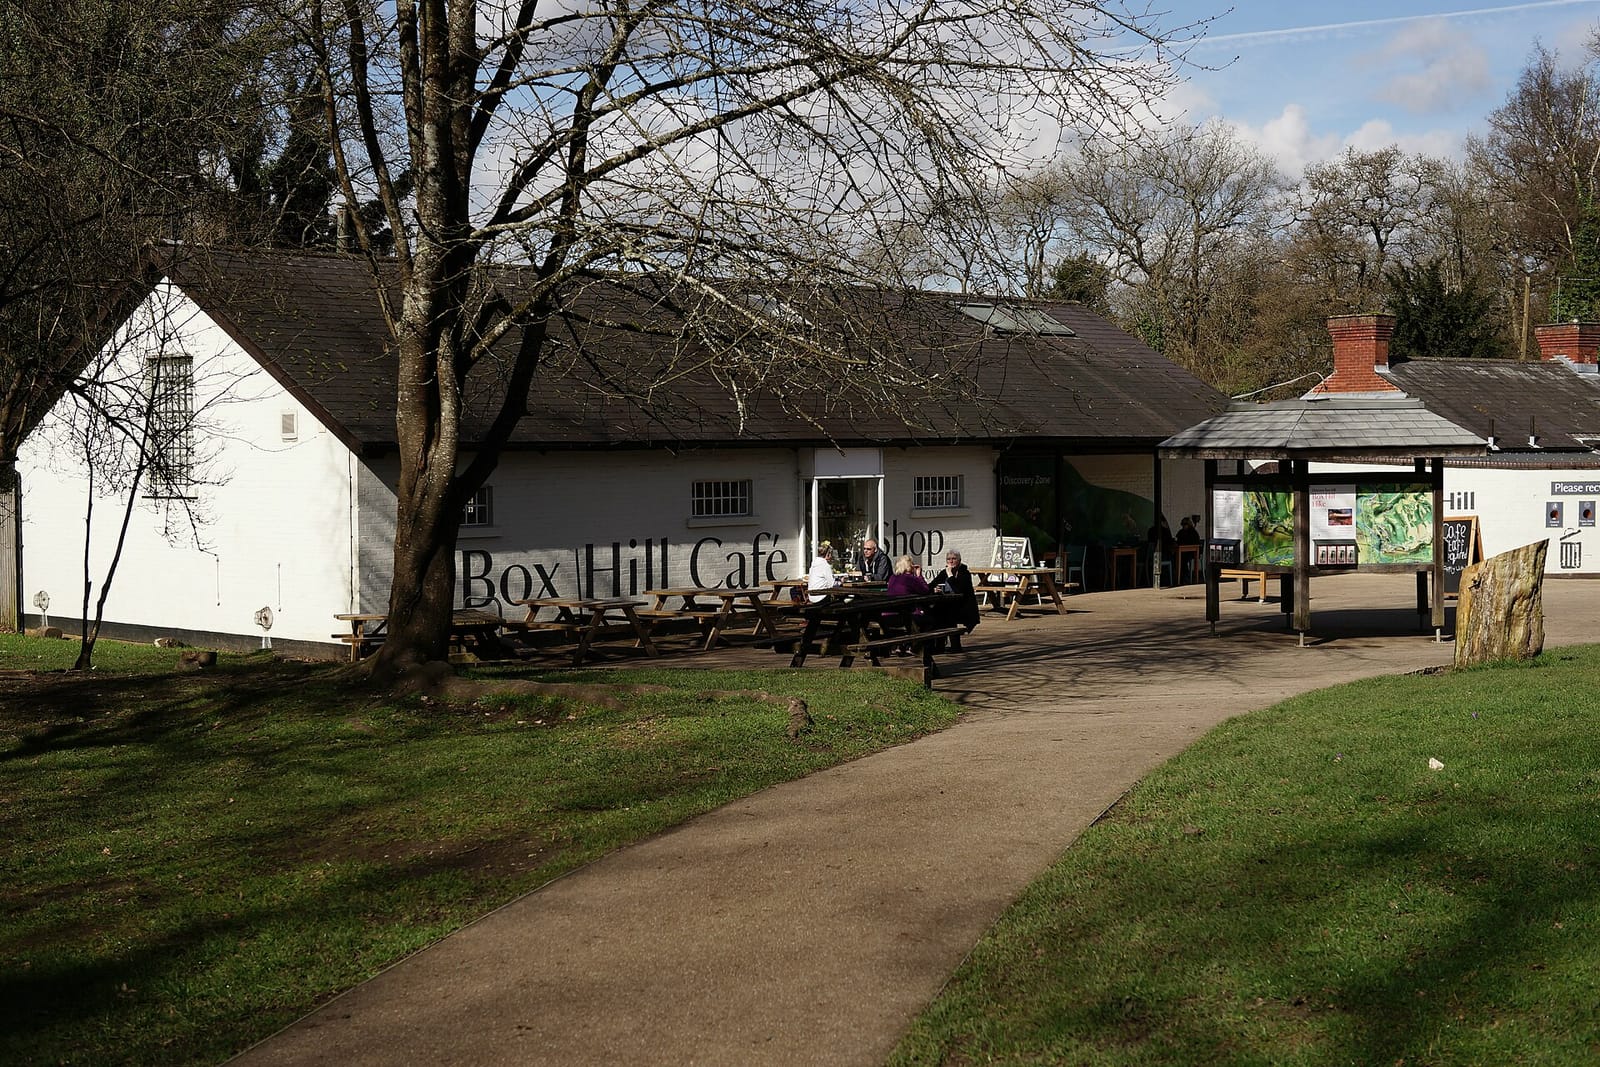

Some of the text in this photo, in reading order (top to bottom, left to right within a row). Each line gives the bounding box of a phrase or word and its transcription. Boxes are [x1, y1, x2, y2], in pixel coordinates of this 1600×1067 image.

[1554, 483, 1584, 493] Please
[1447, 539, 1465, 553] taff
[462, 549, 561, 607] Box
[585, 537, 669, 602] Hill
[689, 531, 788, 590] Café
